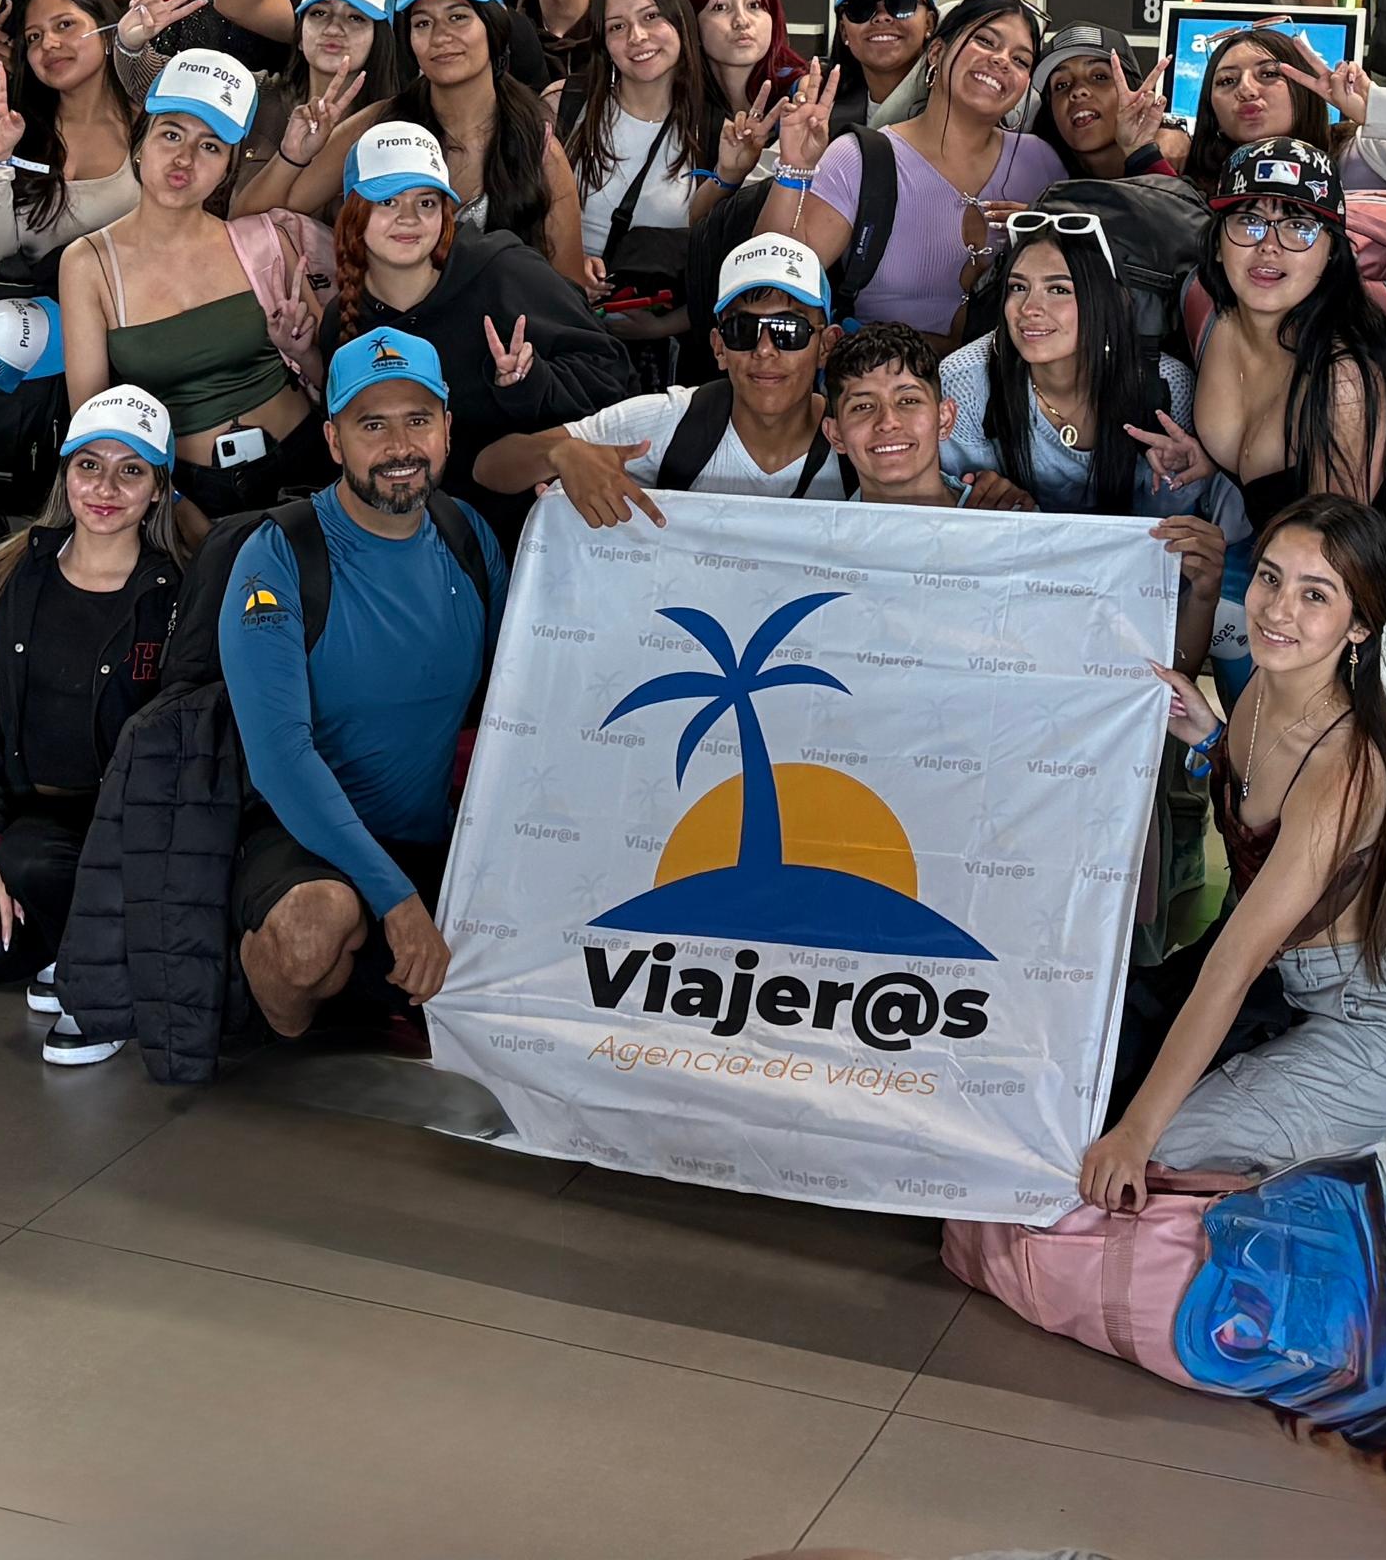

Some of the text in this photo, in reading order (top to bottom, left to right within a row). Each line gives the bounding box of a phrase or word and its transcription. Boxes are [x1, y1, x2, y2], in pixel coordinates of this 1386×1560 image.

[178, 61, 242, 89] Prom 2025
[377, 137, 412, 149] Prom
[734, 246, 803, 265] Prom 2025
[19, 317, 31, 348] Prom
[88, 397, 158, 418] Prom 2025
[589, 545, 652, 562] Viajer@s
[693, 554, 759, 571] Viajer@s
[802, 564, 869, 583] Viajer@s
[913, 573, 980, 591] Viajer@s
[531, 624, 595, 642] Viajer@s
[856, 651, 923, 669] Viajer@s
[968, 656, 1037, 674] Viajer@s
[1083, 662, 1153, 680] Viajer@s
[580, 728, 645, 748] Viajer@s
[800, 748, 868, 766] Viajer@s
[913, 755, 982, 774] Viajer@s
[1027, 760, 1098, 779] Viajer@s
[514, 822, 580, 843] Viajer@s
[965, 860, 1036, 880] Viajer@s
[452, 917, 518, 939] Viajer@s
[789, 950, 860, 972] Viajer@s
[905, 960, 976, 979] Viajer@s
[1023, 966, 1094, 983] Viajer@s
[583, 941, 991, 1052] Viajer@s
[489, 1034, 556, 1054] Viajer@s
[586, 1034, 941, 1097] Agencia de viajes
[957, 1079, 1026, 1096] Viajer@s
[779, 1168, 849, 1190] Viajer@s
[896, 1179, 968, 1200] Viajer@s
